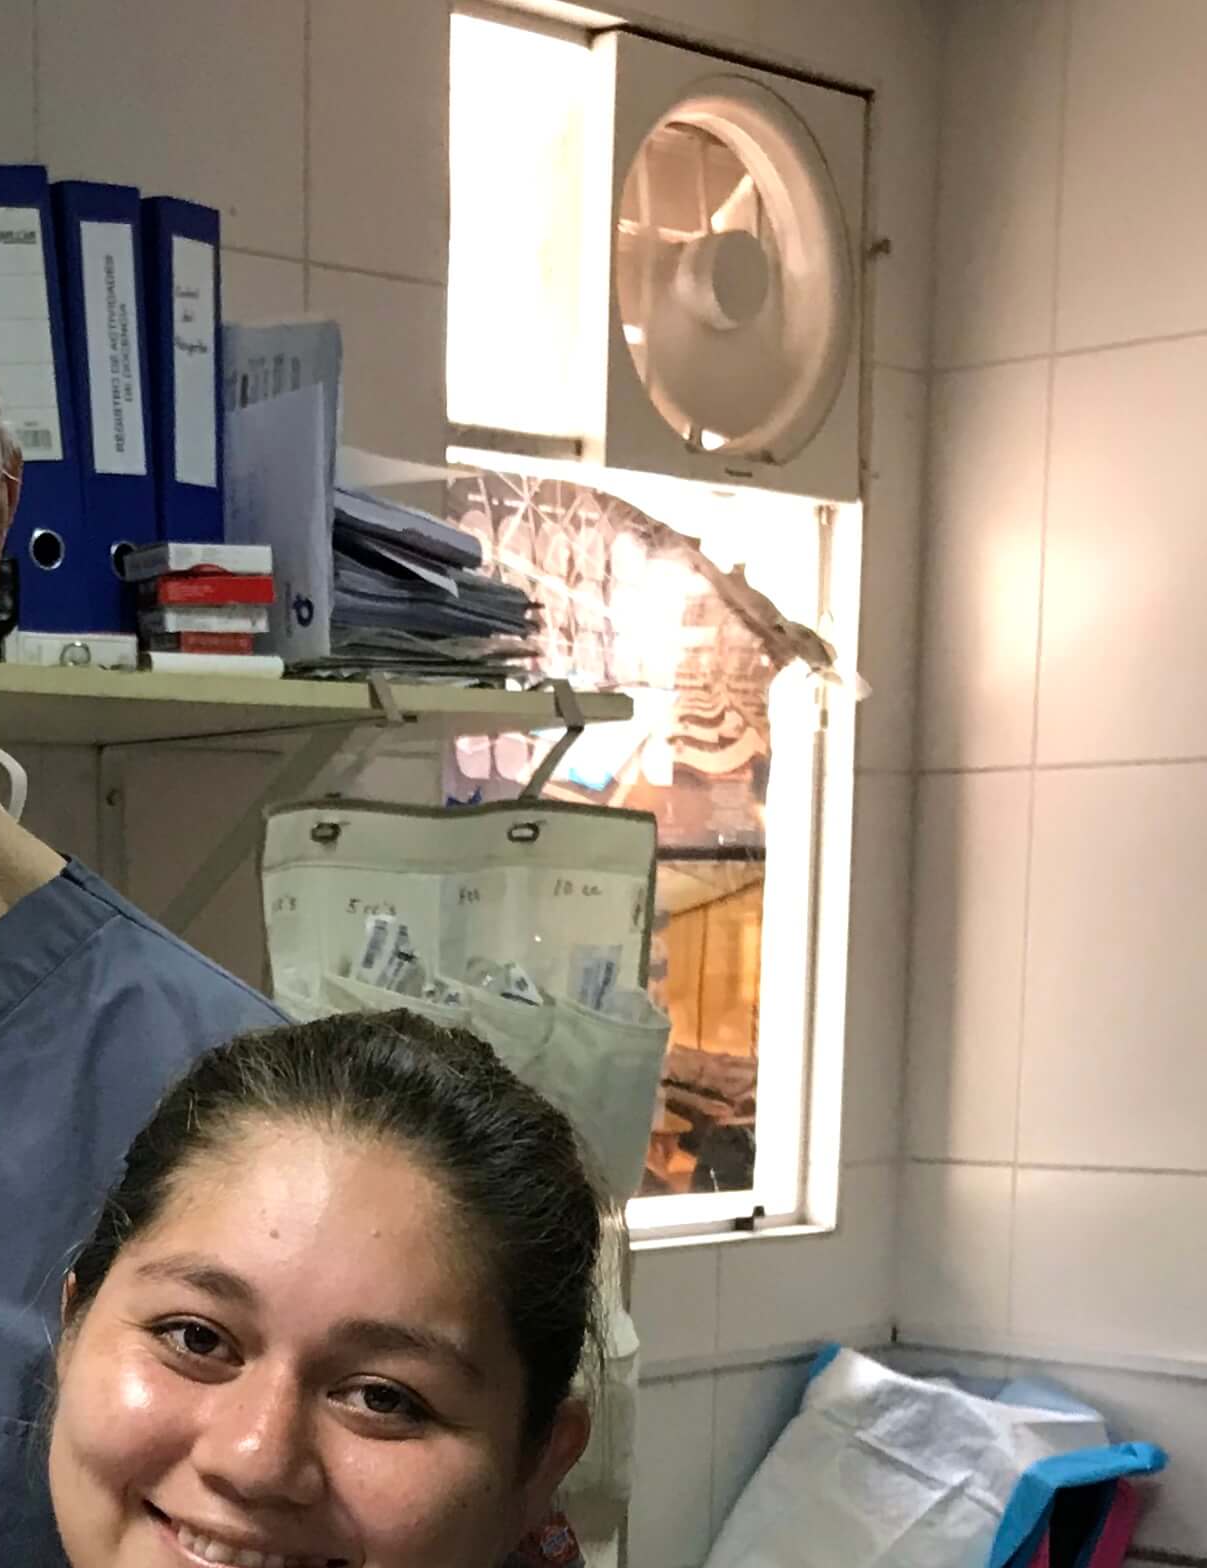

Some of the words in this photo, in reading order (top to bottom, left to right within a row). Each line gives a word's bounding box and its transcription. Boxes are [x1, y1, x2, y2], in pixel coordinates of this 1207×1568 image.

[104, 254, 120, 352] ACTIVIDADES
[118, 303, 132, 379] DOCENCIA
[109, 354, 121, 374] DE
[123, 385, 134, 402] DE
[110, 377, 126, 453] REGISTRO
